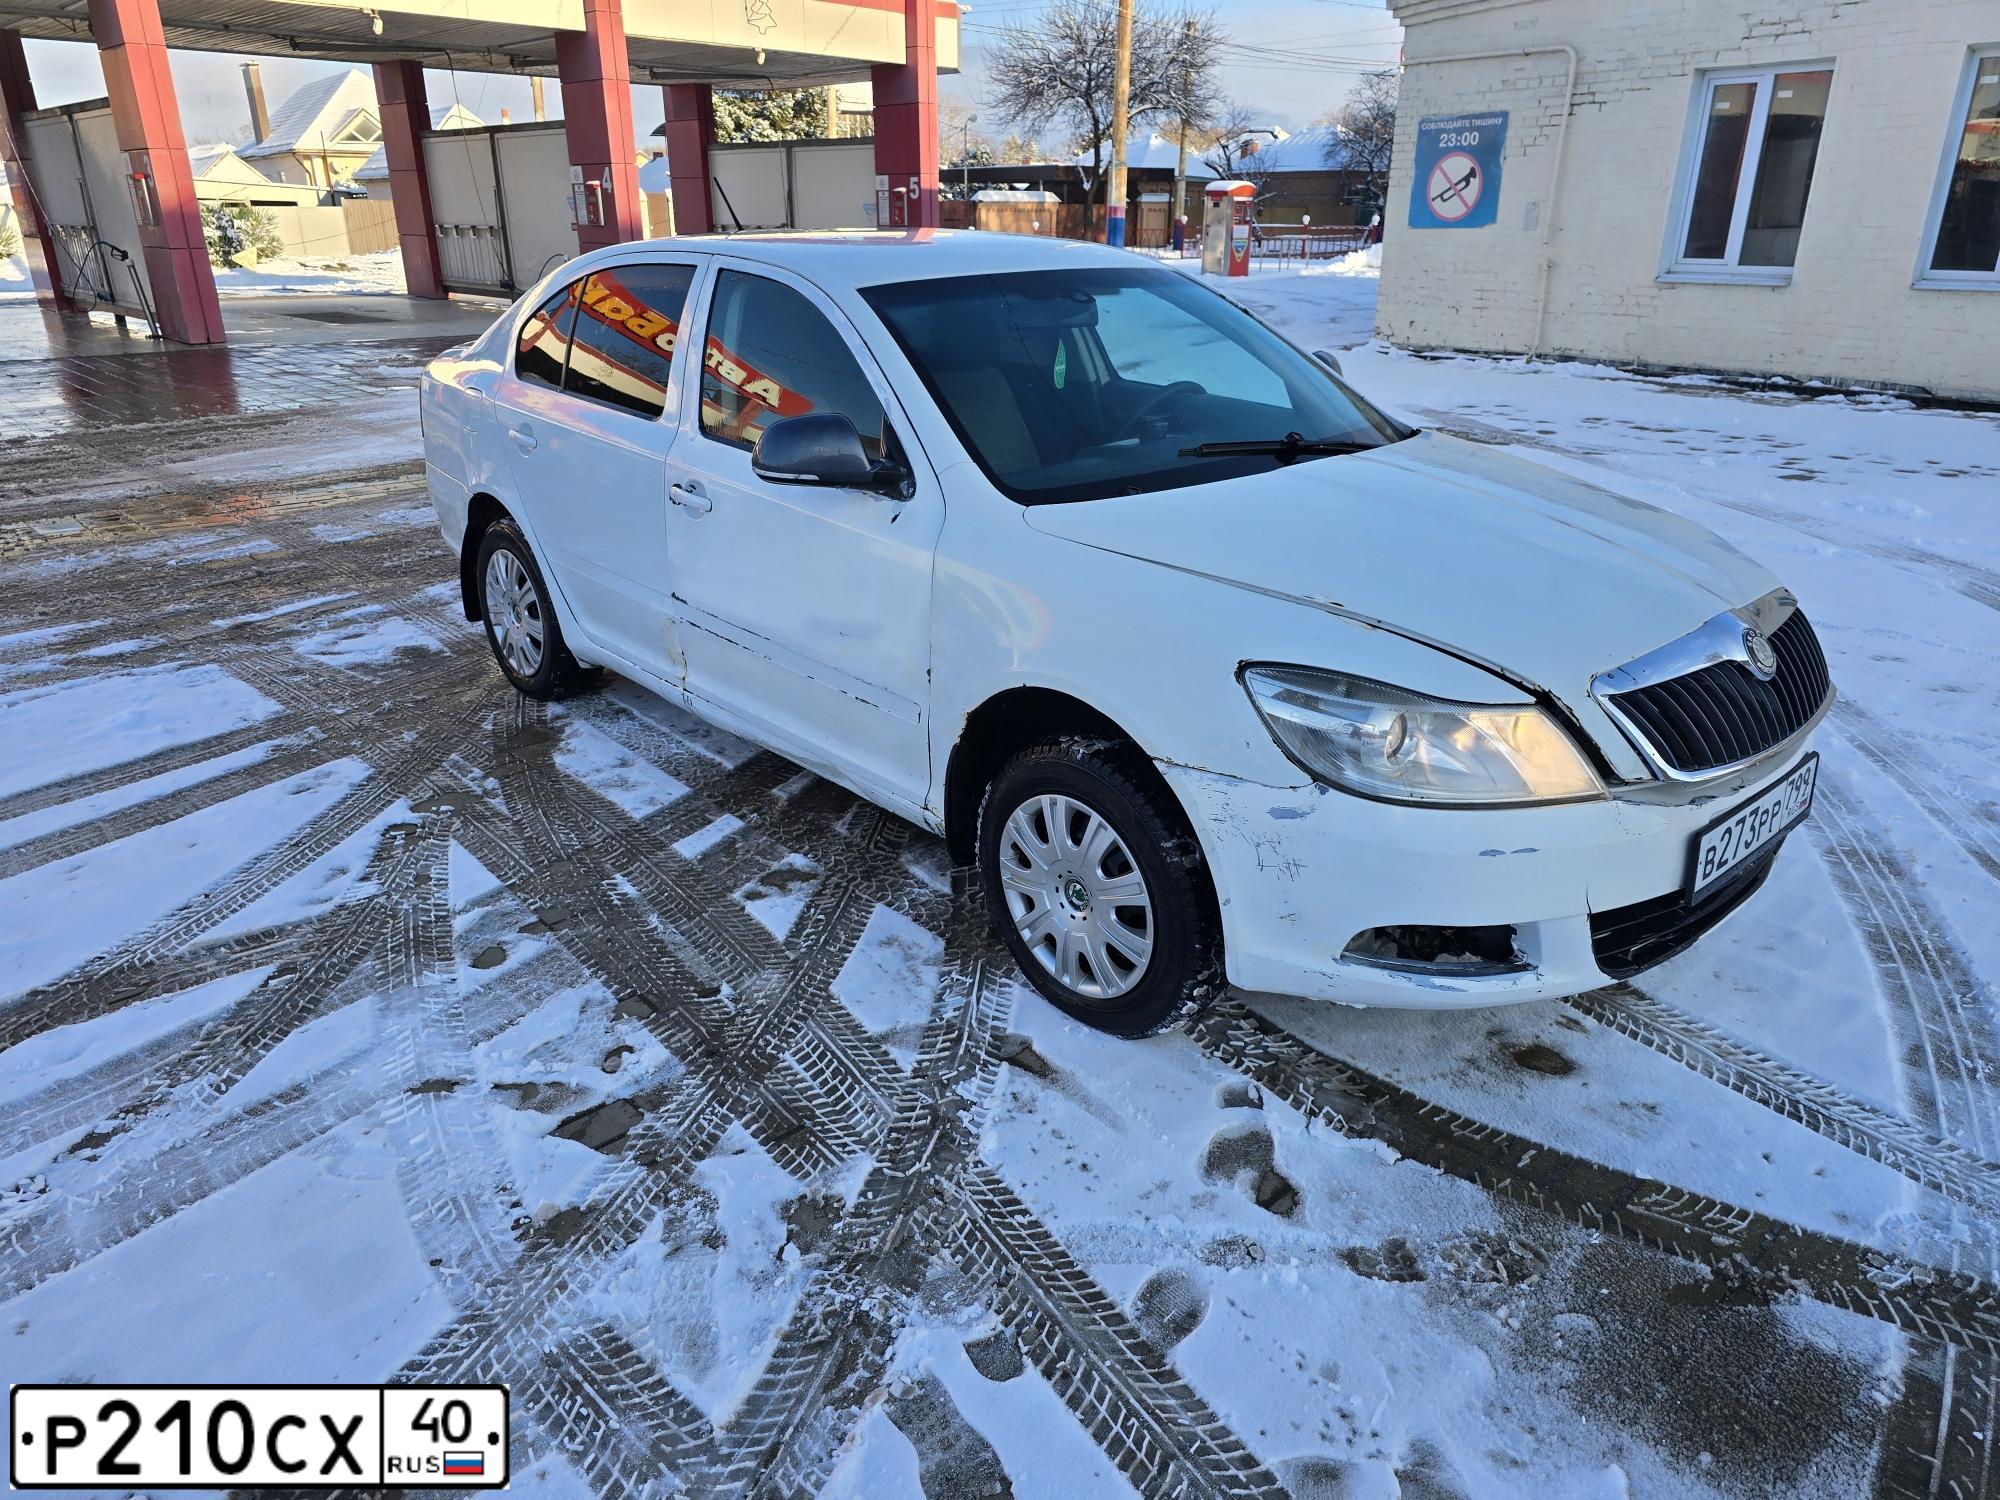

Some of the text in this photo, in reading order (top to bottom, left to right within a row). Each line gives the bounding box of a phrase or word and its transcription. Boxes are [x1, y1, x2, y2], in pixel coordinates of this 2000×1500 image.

[1421, 117, 1503, 130] СОБЛЮДАЙТЕ ТИШИНУ
[1439, 131, 1479, 148] 23:00
[602, 166, 612, 193] 4
[909, 176, 920, 200] 5
[1785, 766, 1811, 810] 799
